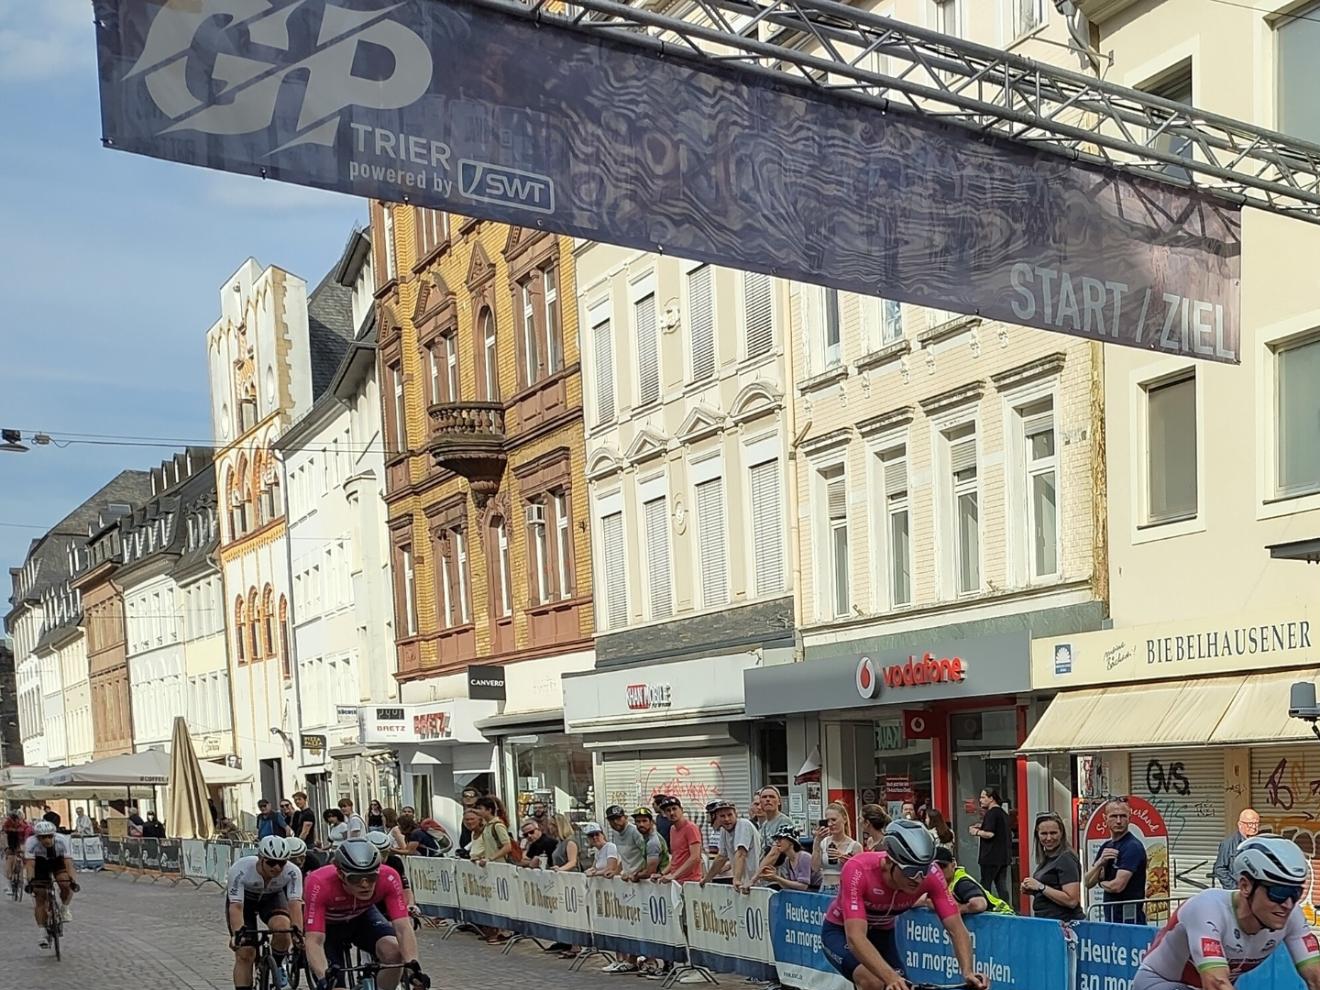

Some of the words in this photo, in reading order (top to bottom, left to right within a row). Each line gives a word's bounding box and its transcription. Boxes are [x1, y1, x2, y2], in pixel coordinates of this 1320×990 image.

[350, 122, 452, 171] TRIER
[348, 160, 427, 190] powered
[430, 173, 453, 198] by
[485, 174, 547, 206] SWT
[1009, 262, 1129, 338] START
[1160, 293, 1235, 360] ZIEL
[1146, 621, 1312, 664] BIEBELHAUSENER
[881, 651, 968, 688] vodafone
[604, 889, 642, 926] Bitburger
[785, 902, 809, 924] Heute
[785, 929, 796, 943] an
[797, 931, 823, 953] morge
[906, 919, 940, 944] Heute
[906, 950, 920, 968] an
[923, 953, 960, 979] morge
[1080, 938, 1127, 966] Heute
